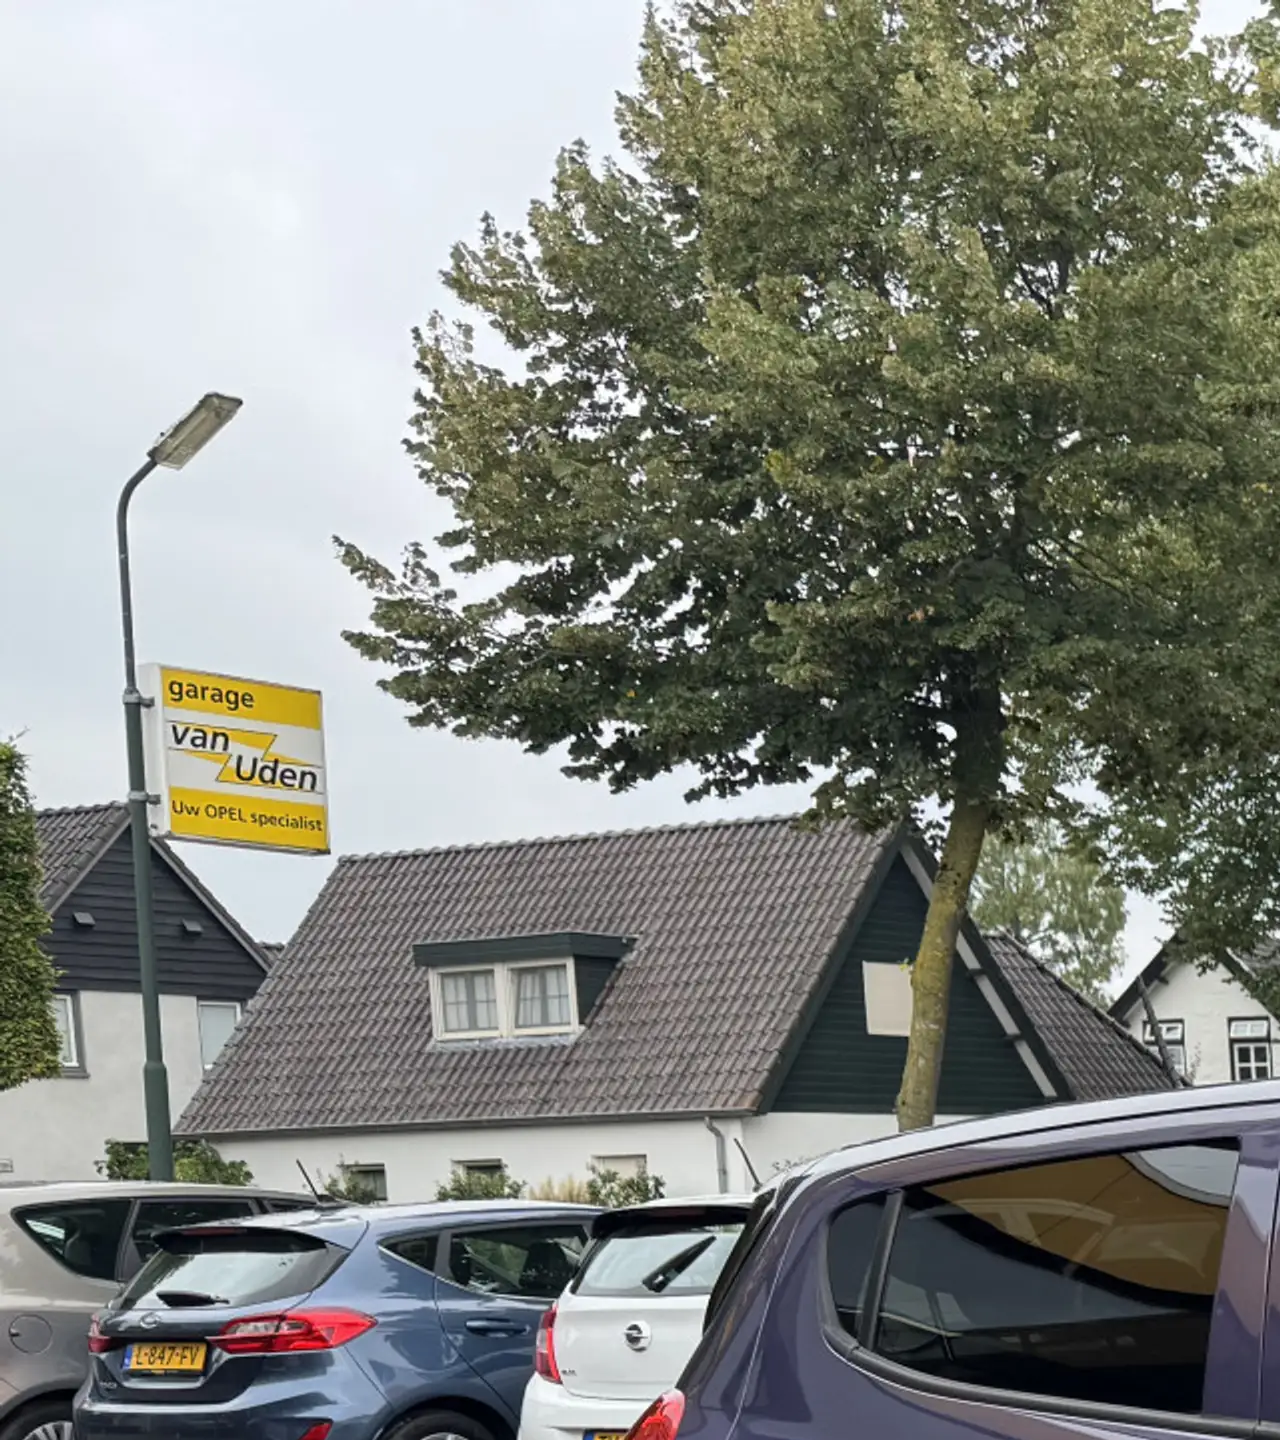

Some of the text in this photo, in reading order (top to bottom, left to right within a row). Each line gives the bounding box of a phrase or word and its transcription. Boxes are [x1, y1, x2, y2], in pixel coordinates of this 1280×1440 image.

[168, 679, 255, 711] garage
[171, 723, 230, 752] van
[235, 754, 318, 791] Uden
[171, 799, 323, 832] Uw OPEL specialist
